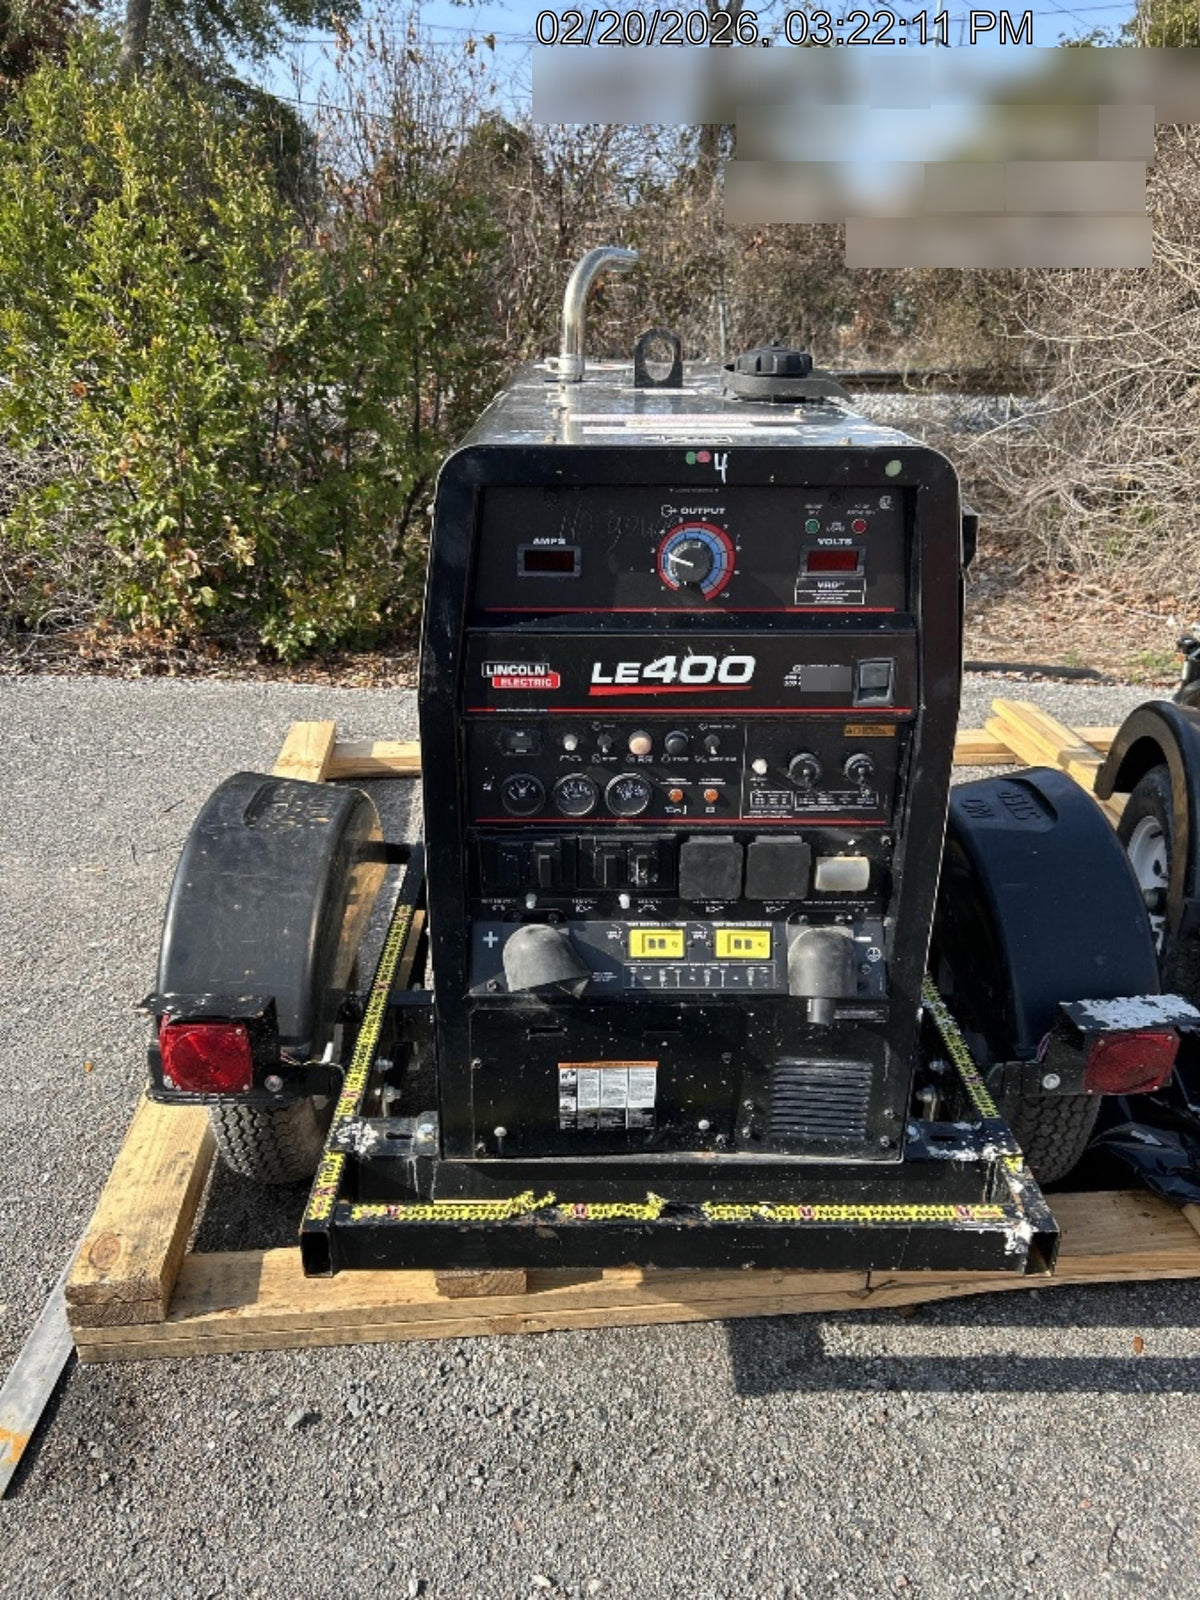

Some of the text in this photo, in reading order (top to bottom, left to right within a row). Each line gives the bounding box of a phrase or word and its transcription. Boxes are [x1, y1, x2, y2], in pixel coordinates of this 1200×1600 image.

[714, 452, 729, 484] 4
[680, 507, 726, 515] OUTPUT
[533, 537, 567, 545] AMPS
[817, 538, 853, 546] VOLTS
[486, 664, 545, 676] LINCOLN
[590, 655, 757, 684] LE400
[500, 678, 552, 687] ELECTRIC
[432, 1208, 466, 1217] NOT
[818, 1208, 953, 1217] NO SE PARE AQUI
